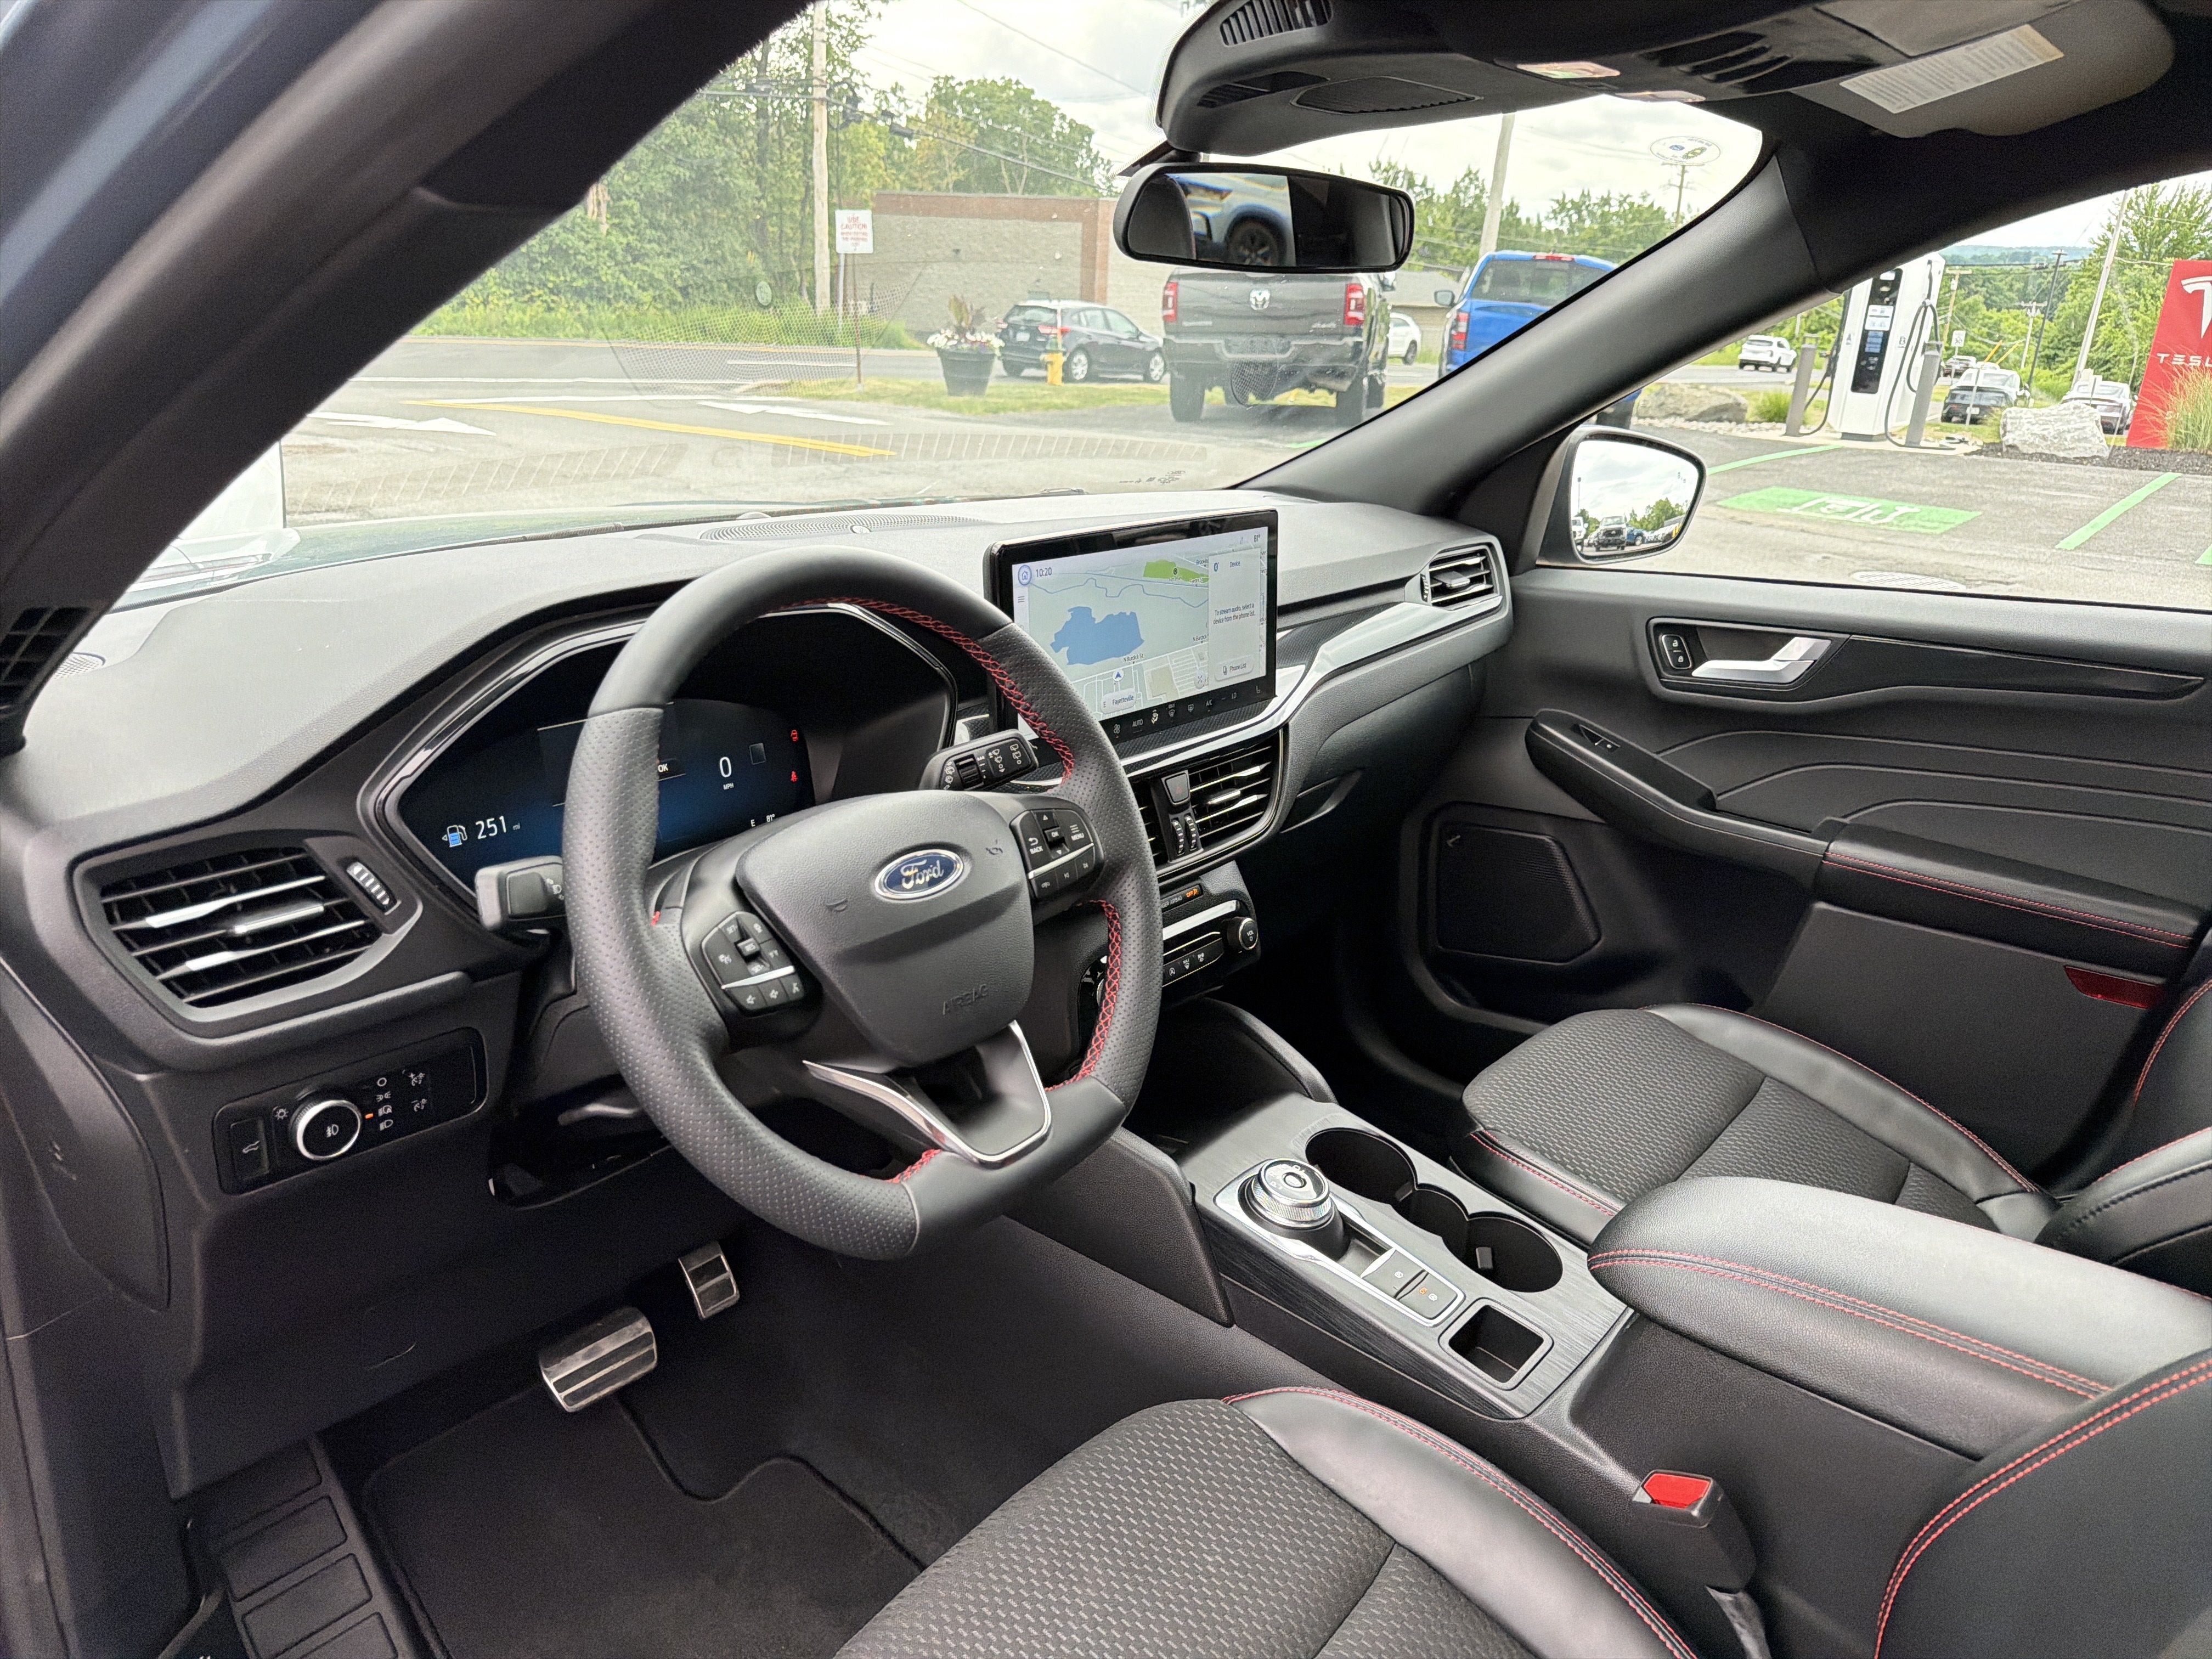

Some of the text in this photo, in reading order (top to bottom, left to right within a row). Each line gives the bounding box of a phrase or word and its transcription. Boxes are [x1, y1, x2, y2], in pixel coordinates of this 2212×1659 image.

[1036, 567, 1052, 578] 10:20
[1239, 612, 1249, 620] phone
[1229, 664, 1240, 672] Phone
[1112, 695, 1134, 706] Fayetteville
[1132, 719, 1143, 727] AUTO
[658, 763, 669, 773] OK
[719, 756, 732, 778] 0
[475, 815, 506, 839] 251
[751, 819, 755, 827] E
[1071, 832, 1085, 841] MENU
[1029, 845, 1043, 854] BACK
[900, 859, 944, 889] Ford
[1170, 895, 1183, 905] AIRBAG
